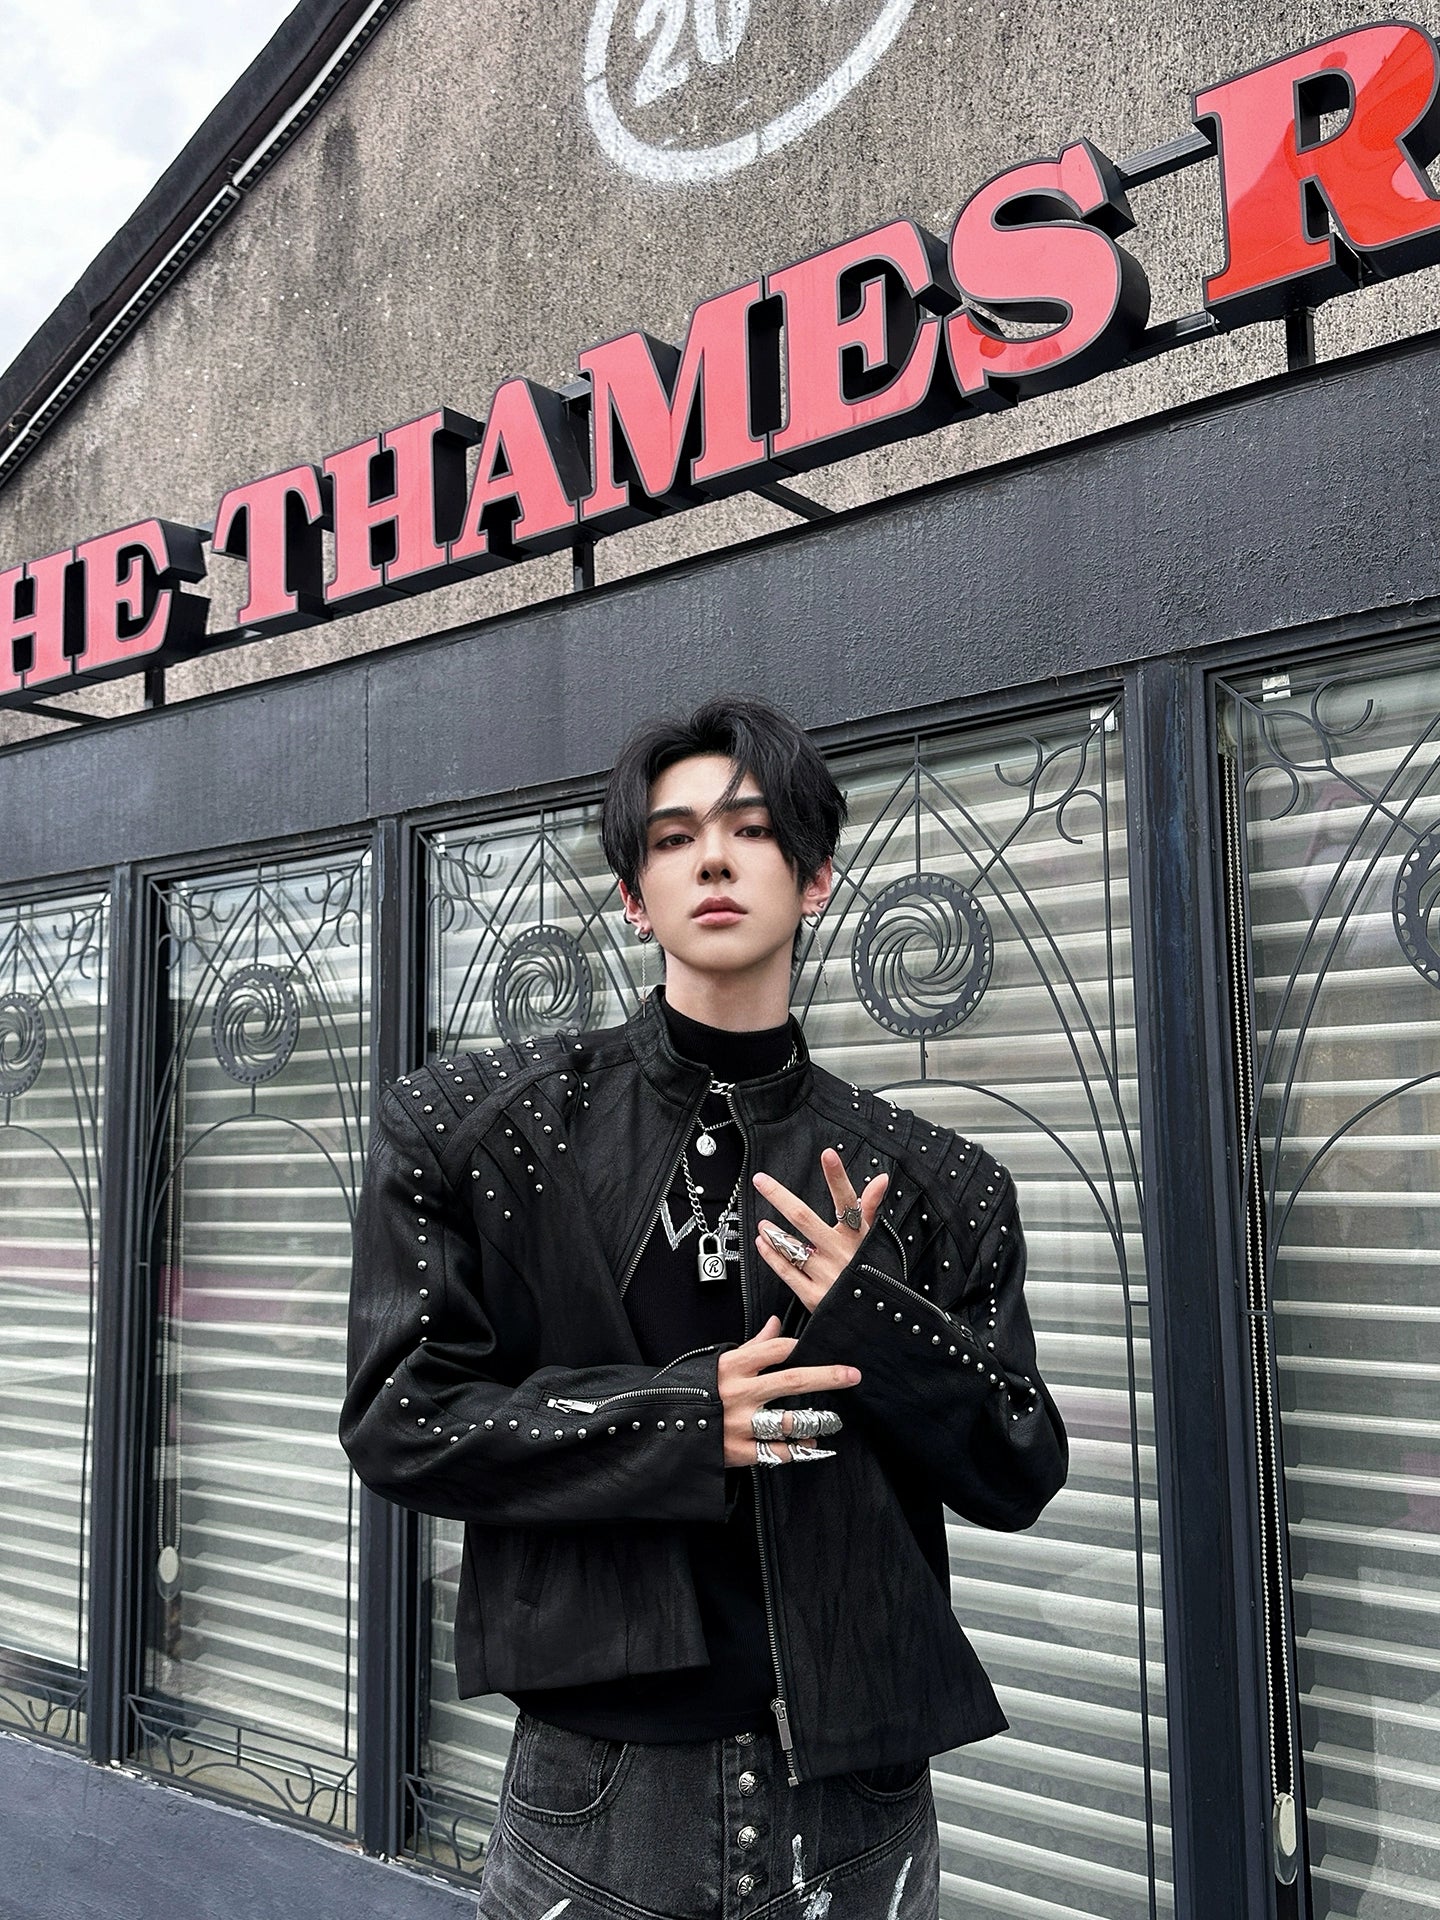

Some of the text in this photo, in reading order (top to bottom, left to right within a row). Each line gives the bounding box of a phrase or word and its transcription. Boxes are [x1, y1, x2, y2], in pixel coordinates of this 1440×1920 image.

[0, 19, 1440, 696] HE THAMES R
